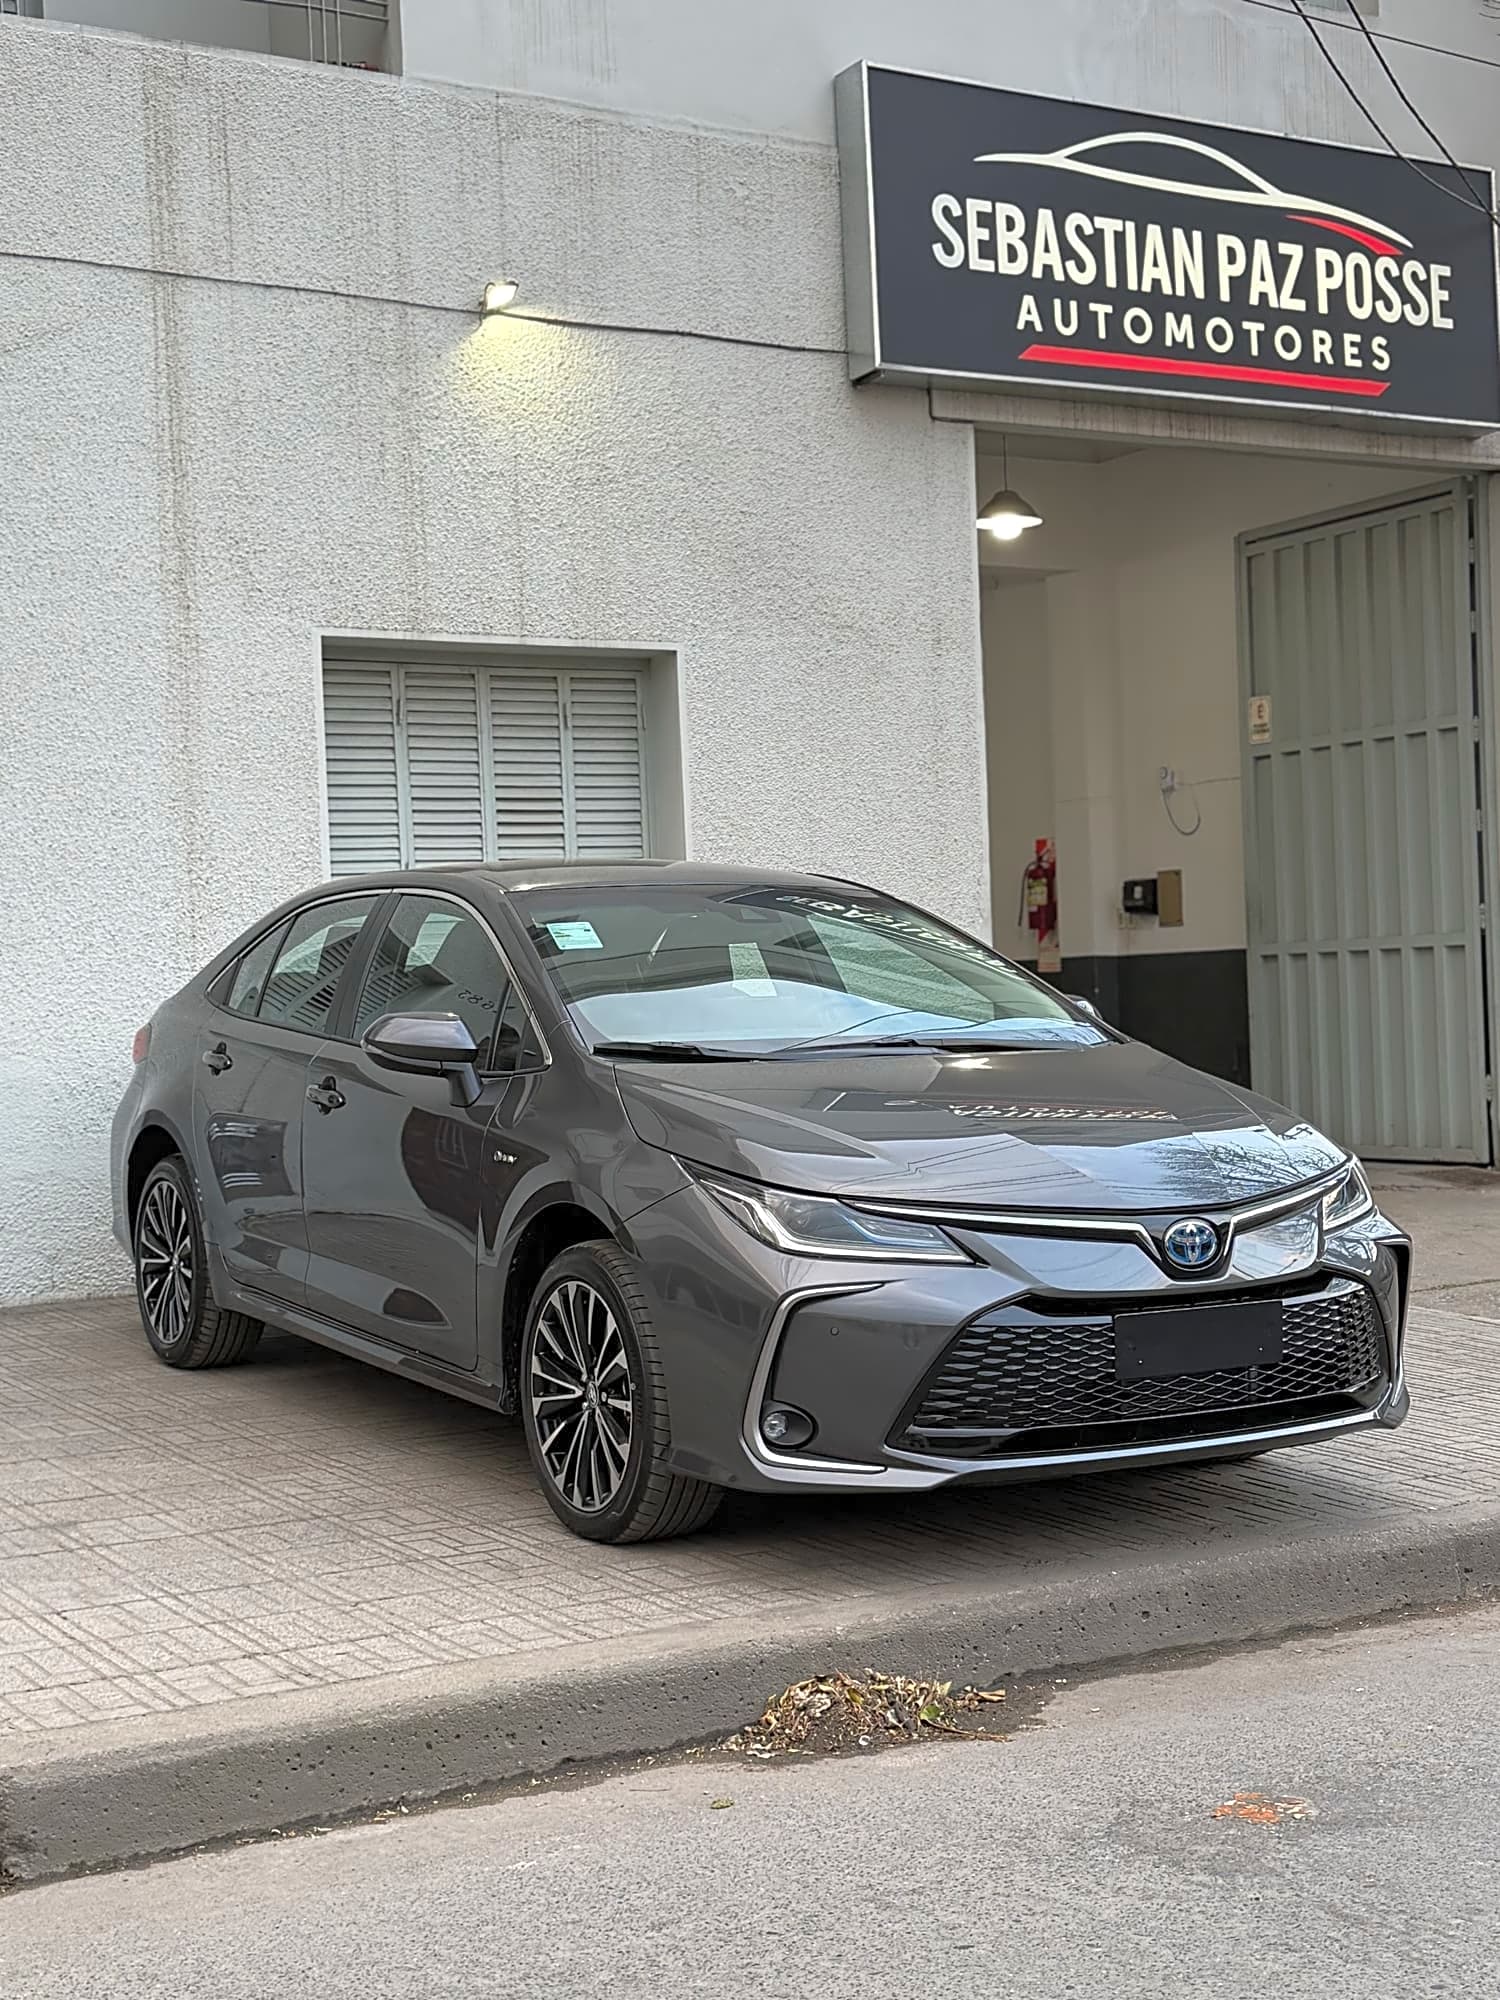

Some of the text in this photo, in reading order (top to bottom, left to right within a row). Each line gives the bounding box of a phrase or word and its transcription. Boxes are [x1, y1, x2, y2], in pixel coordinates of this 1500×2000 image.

[931, 193, 1455, 330] SEBASTIAN PAZ POSSE
[1016, 294, 1391, 372] AUTOMOTORES
